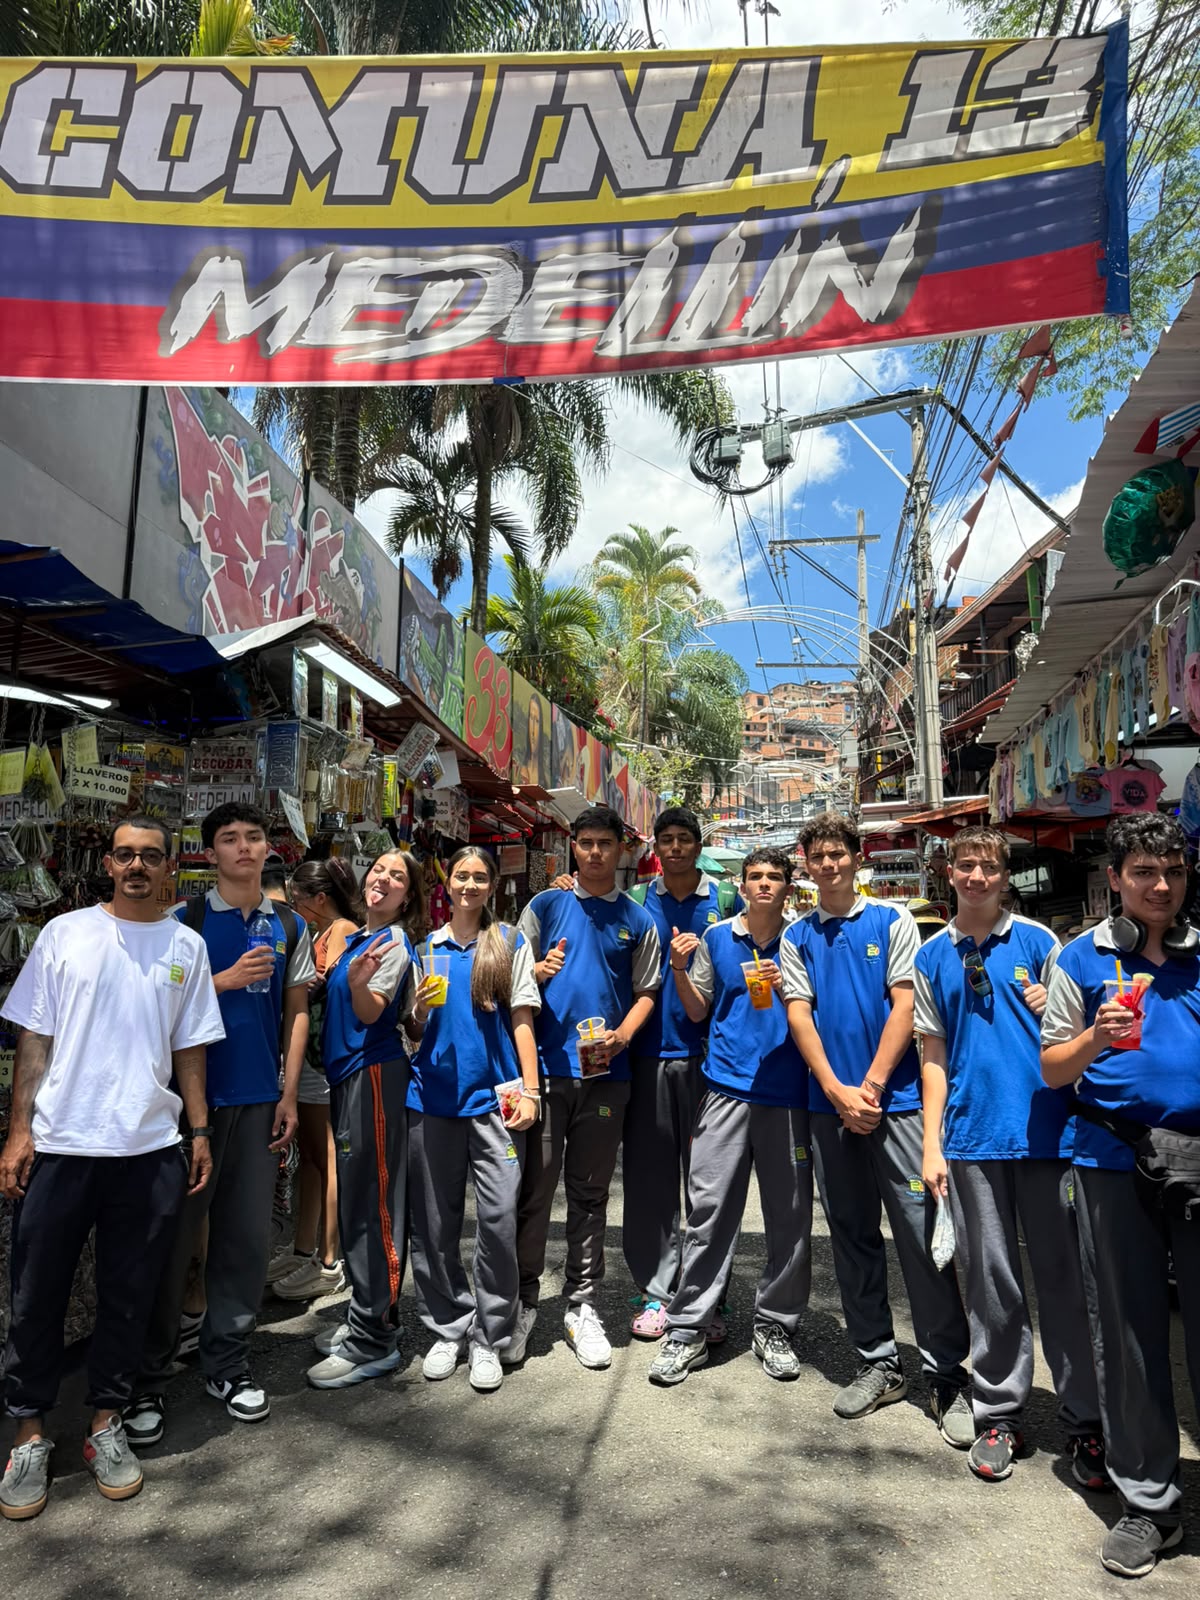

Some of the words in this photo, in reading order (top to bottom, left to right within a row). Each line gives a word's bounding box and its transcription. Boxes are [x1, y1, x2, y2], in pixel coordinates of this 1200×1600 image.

[0, 61, 827, 206] COMUNA
[876, 37, 1107, 172] 13
[194, 758, 253, 770] ESCOBAR
[74, 766, 129, 783] LLAVEROS
[71, 778, 79, 787] 2
[82, 780, 90, 789] X
[93, 782, 127, 796] 10.000
